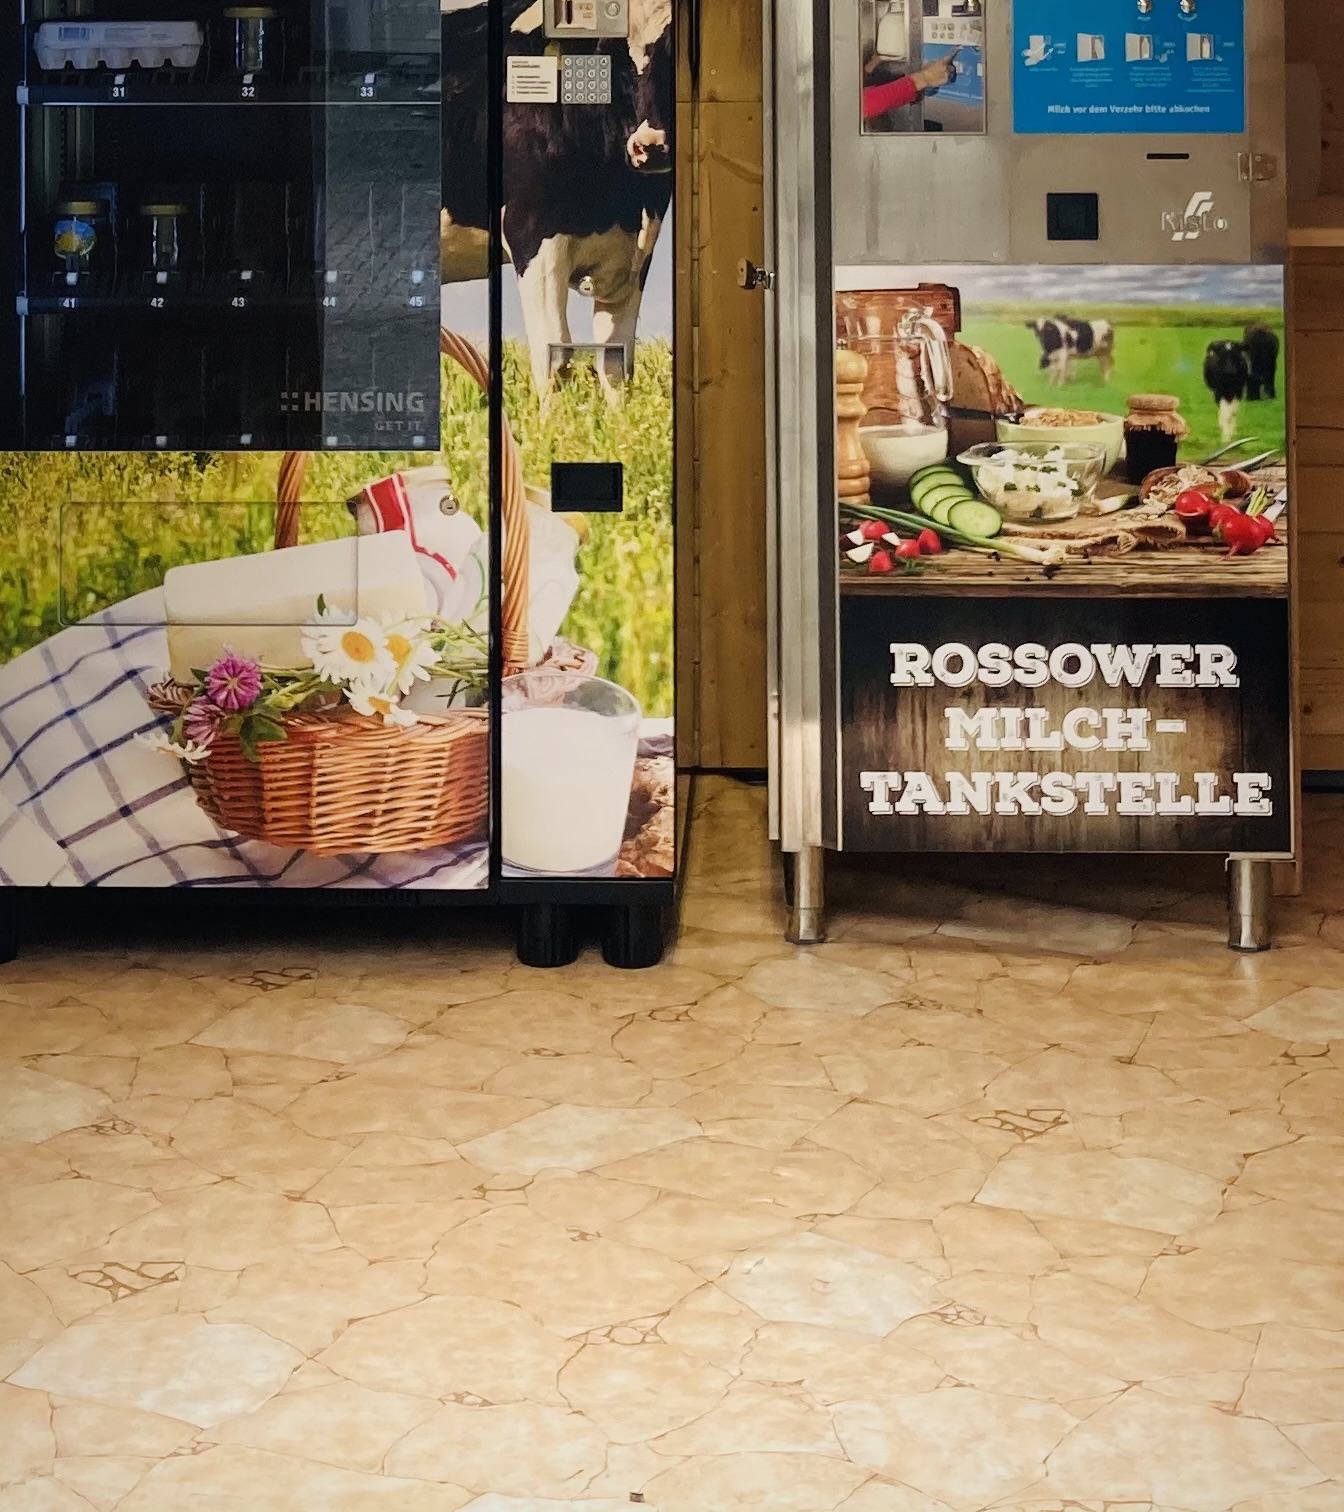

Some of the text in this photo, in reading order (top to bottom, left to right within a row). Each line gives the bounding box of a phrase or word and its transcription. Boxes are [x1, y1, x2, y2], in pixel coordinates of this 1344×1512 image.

[112, 87, 125, 97] 31
[241, 86, 255, 97] 32
[360, 86, 373, 97] 33
[1047, 105, 1071, 114] Milch
[1089, 105, 1107, 113] dem
[1145, 105, 1167, 113] bitte
[1169, 105, 1211, 113] abkochen
[63, 298, 76, 308] 41
[150, 297, 165, 308] 42
[232, 296, 245, 307] 43
[323, 296, 336, 307] 44
[409, 296, 423, 307] 45
[305, 391, 425, 413] HENSING
[375, 420, 402, 431] GET
[889, 642, 1240, 688] ROSSOWER
[944, 707, 1187, 751] MILCH-
[859, 772, 1273, 816] TANKSTELLE
